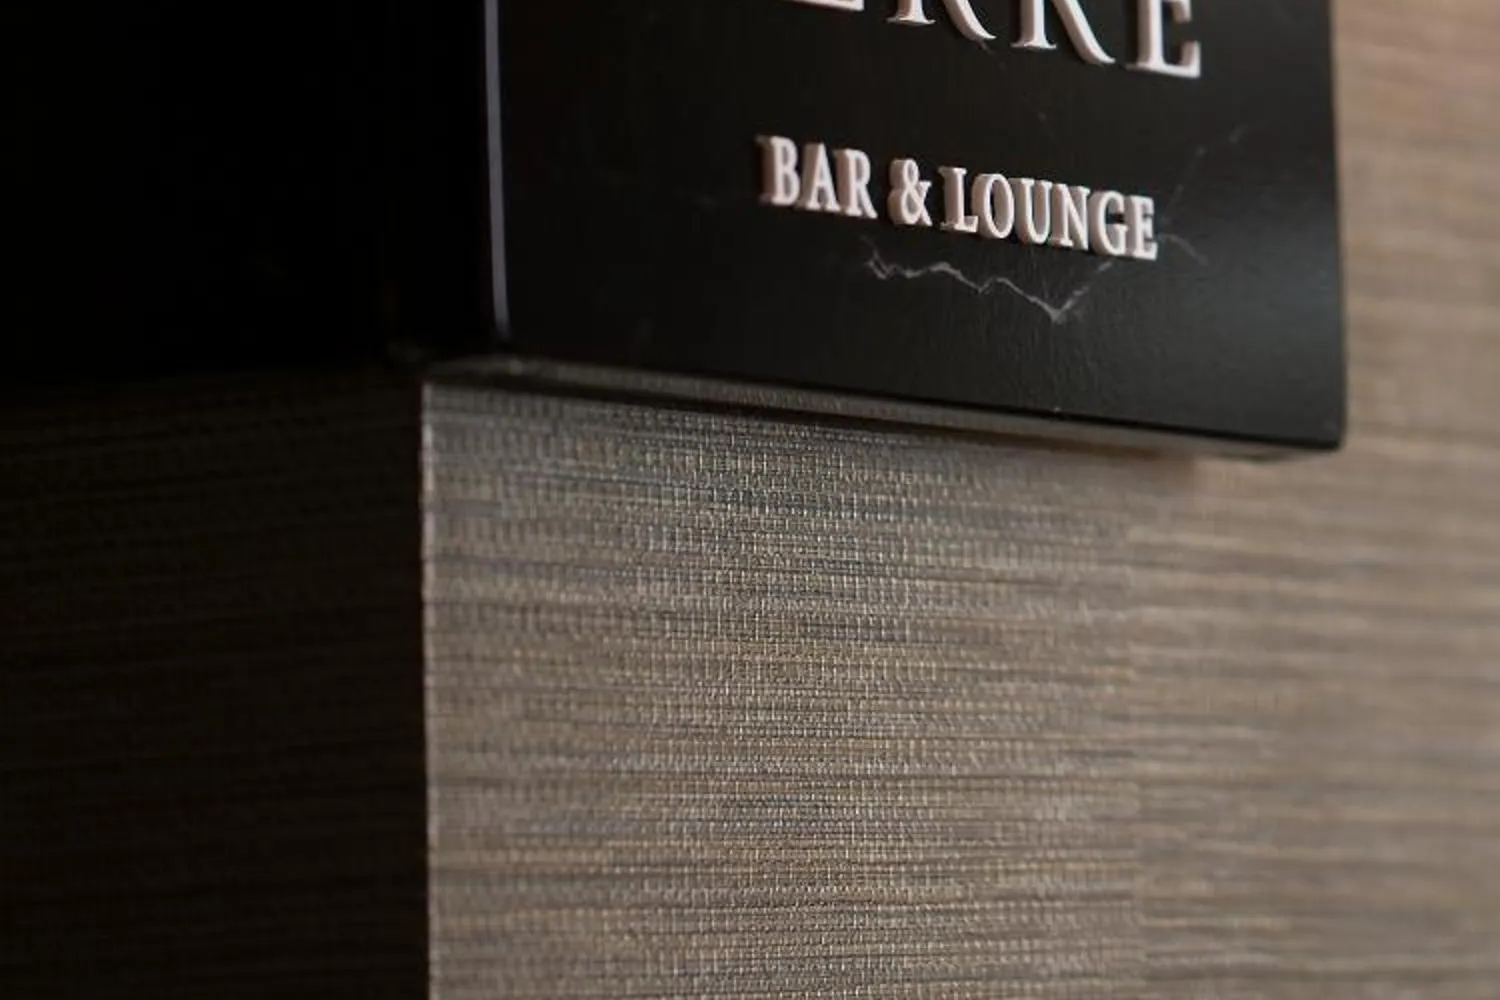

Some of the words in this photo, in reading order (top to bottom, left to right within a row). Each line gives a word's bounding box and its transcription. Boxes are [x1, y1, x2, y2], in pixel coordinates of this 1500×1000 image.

[758, 134, 878, 220] BAR
[889, 158, 933, 228] &
[940, 166, 1159, 262] LOUNGE
